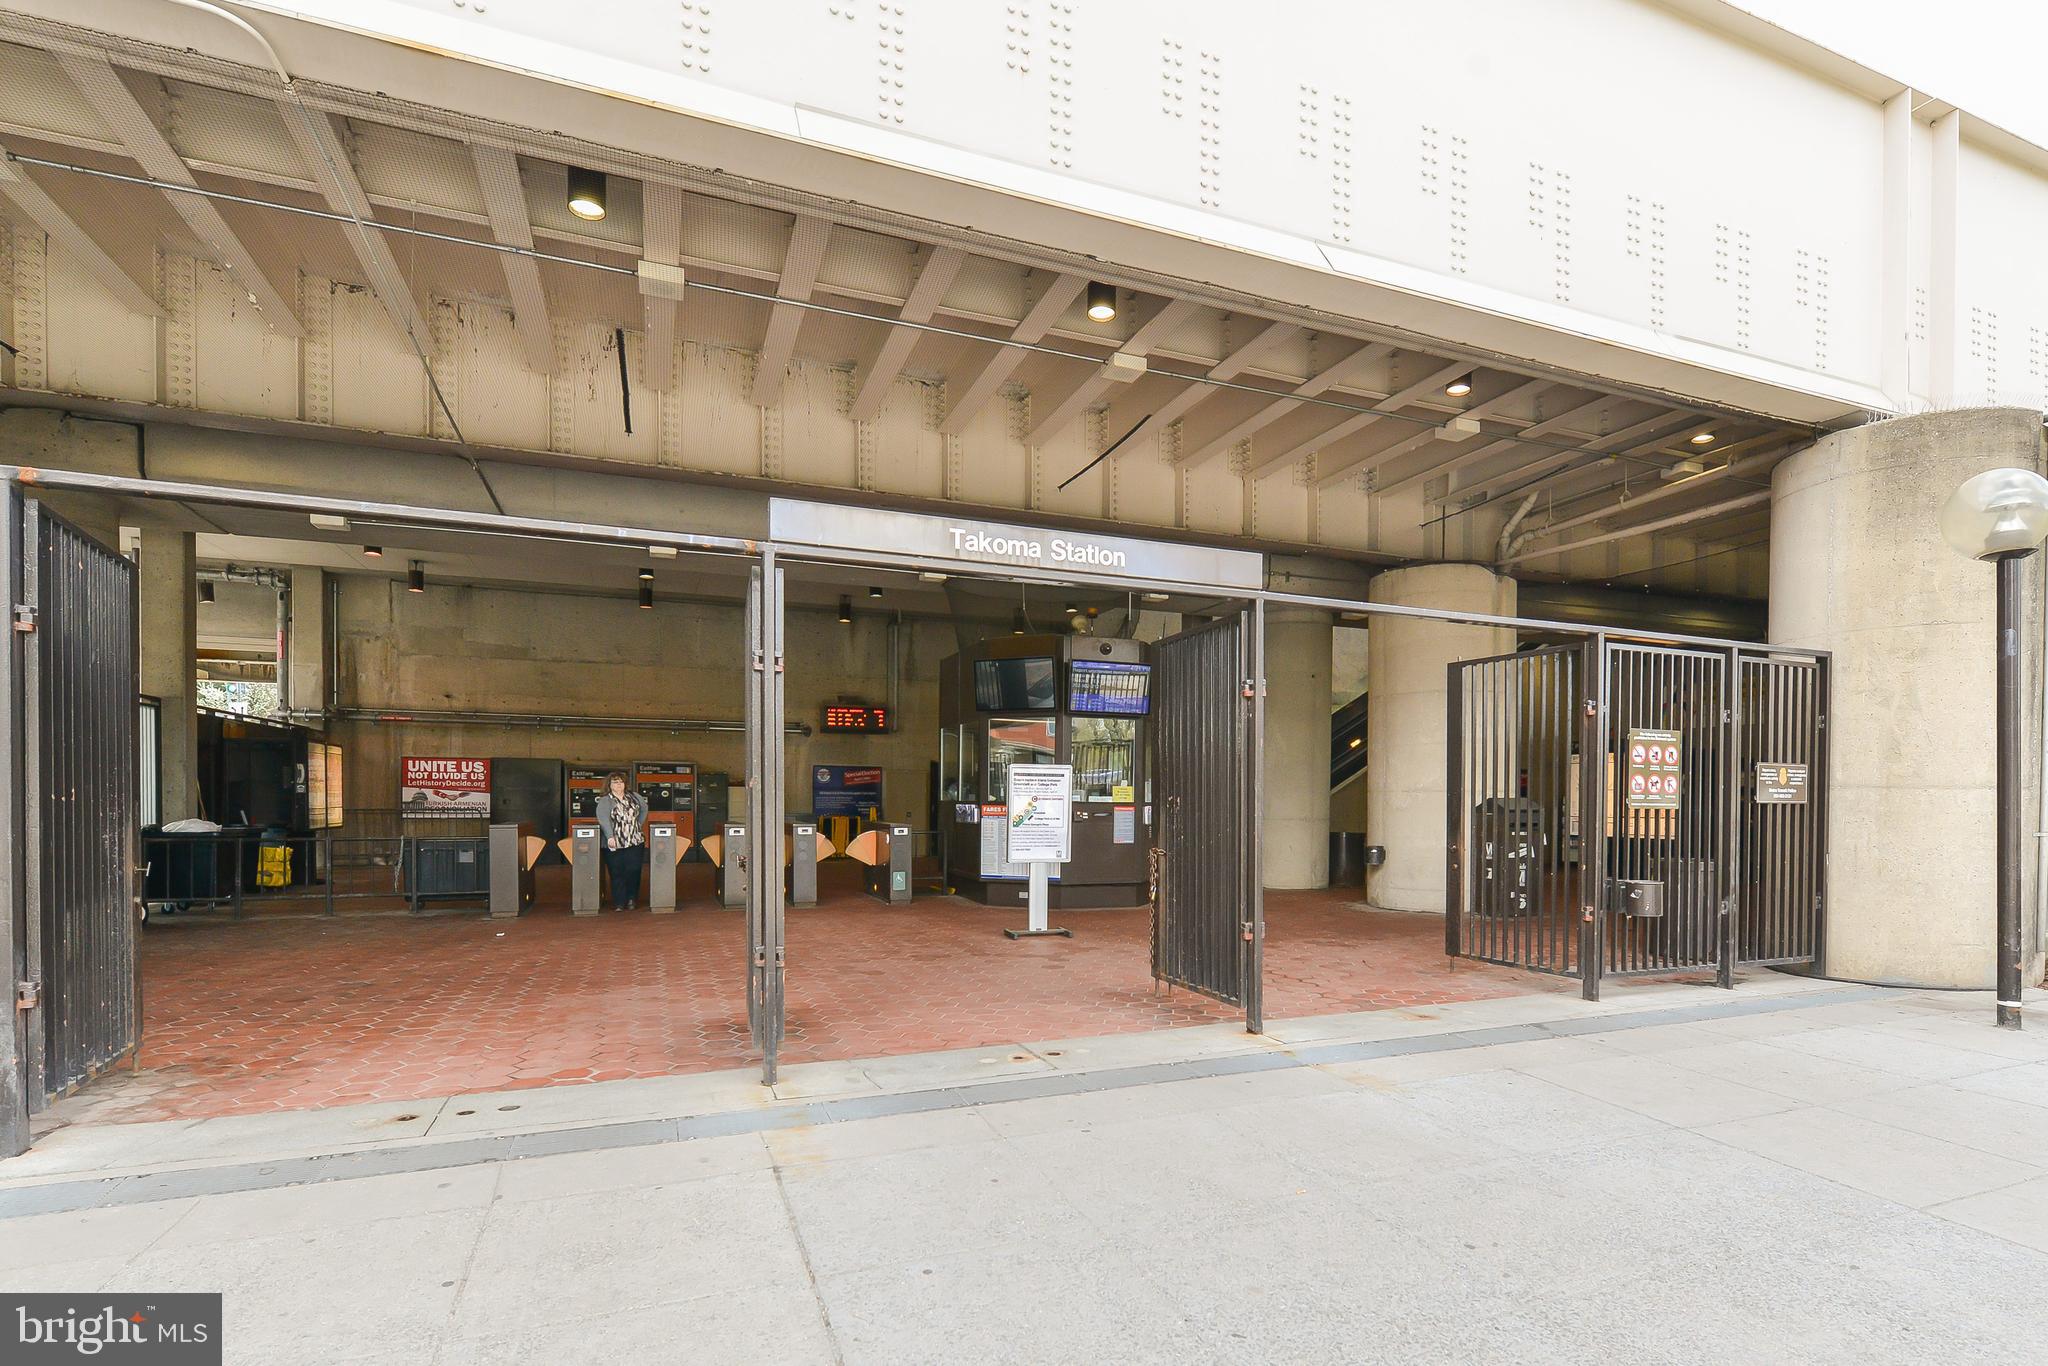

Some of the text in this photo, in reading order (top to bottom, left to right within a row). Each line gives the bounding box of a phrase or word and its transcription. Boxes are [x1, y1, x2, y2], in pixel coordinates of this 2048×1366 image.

[949, 528, 1126, 568] Takoma Station
[407, 760, 487, 774] UNITE US,
[432, 772, 468, 780] DIVIDE
[407, 780, 486, 788] LetHistoryDecide.org
